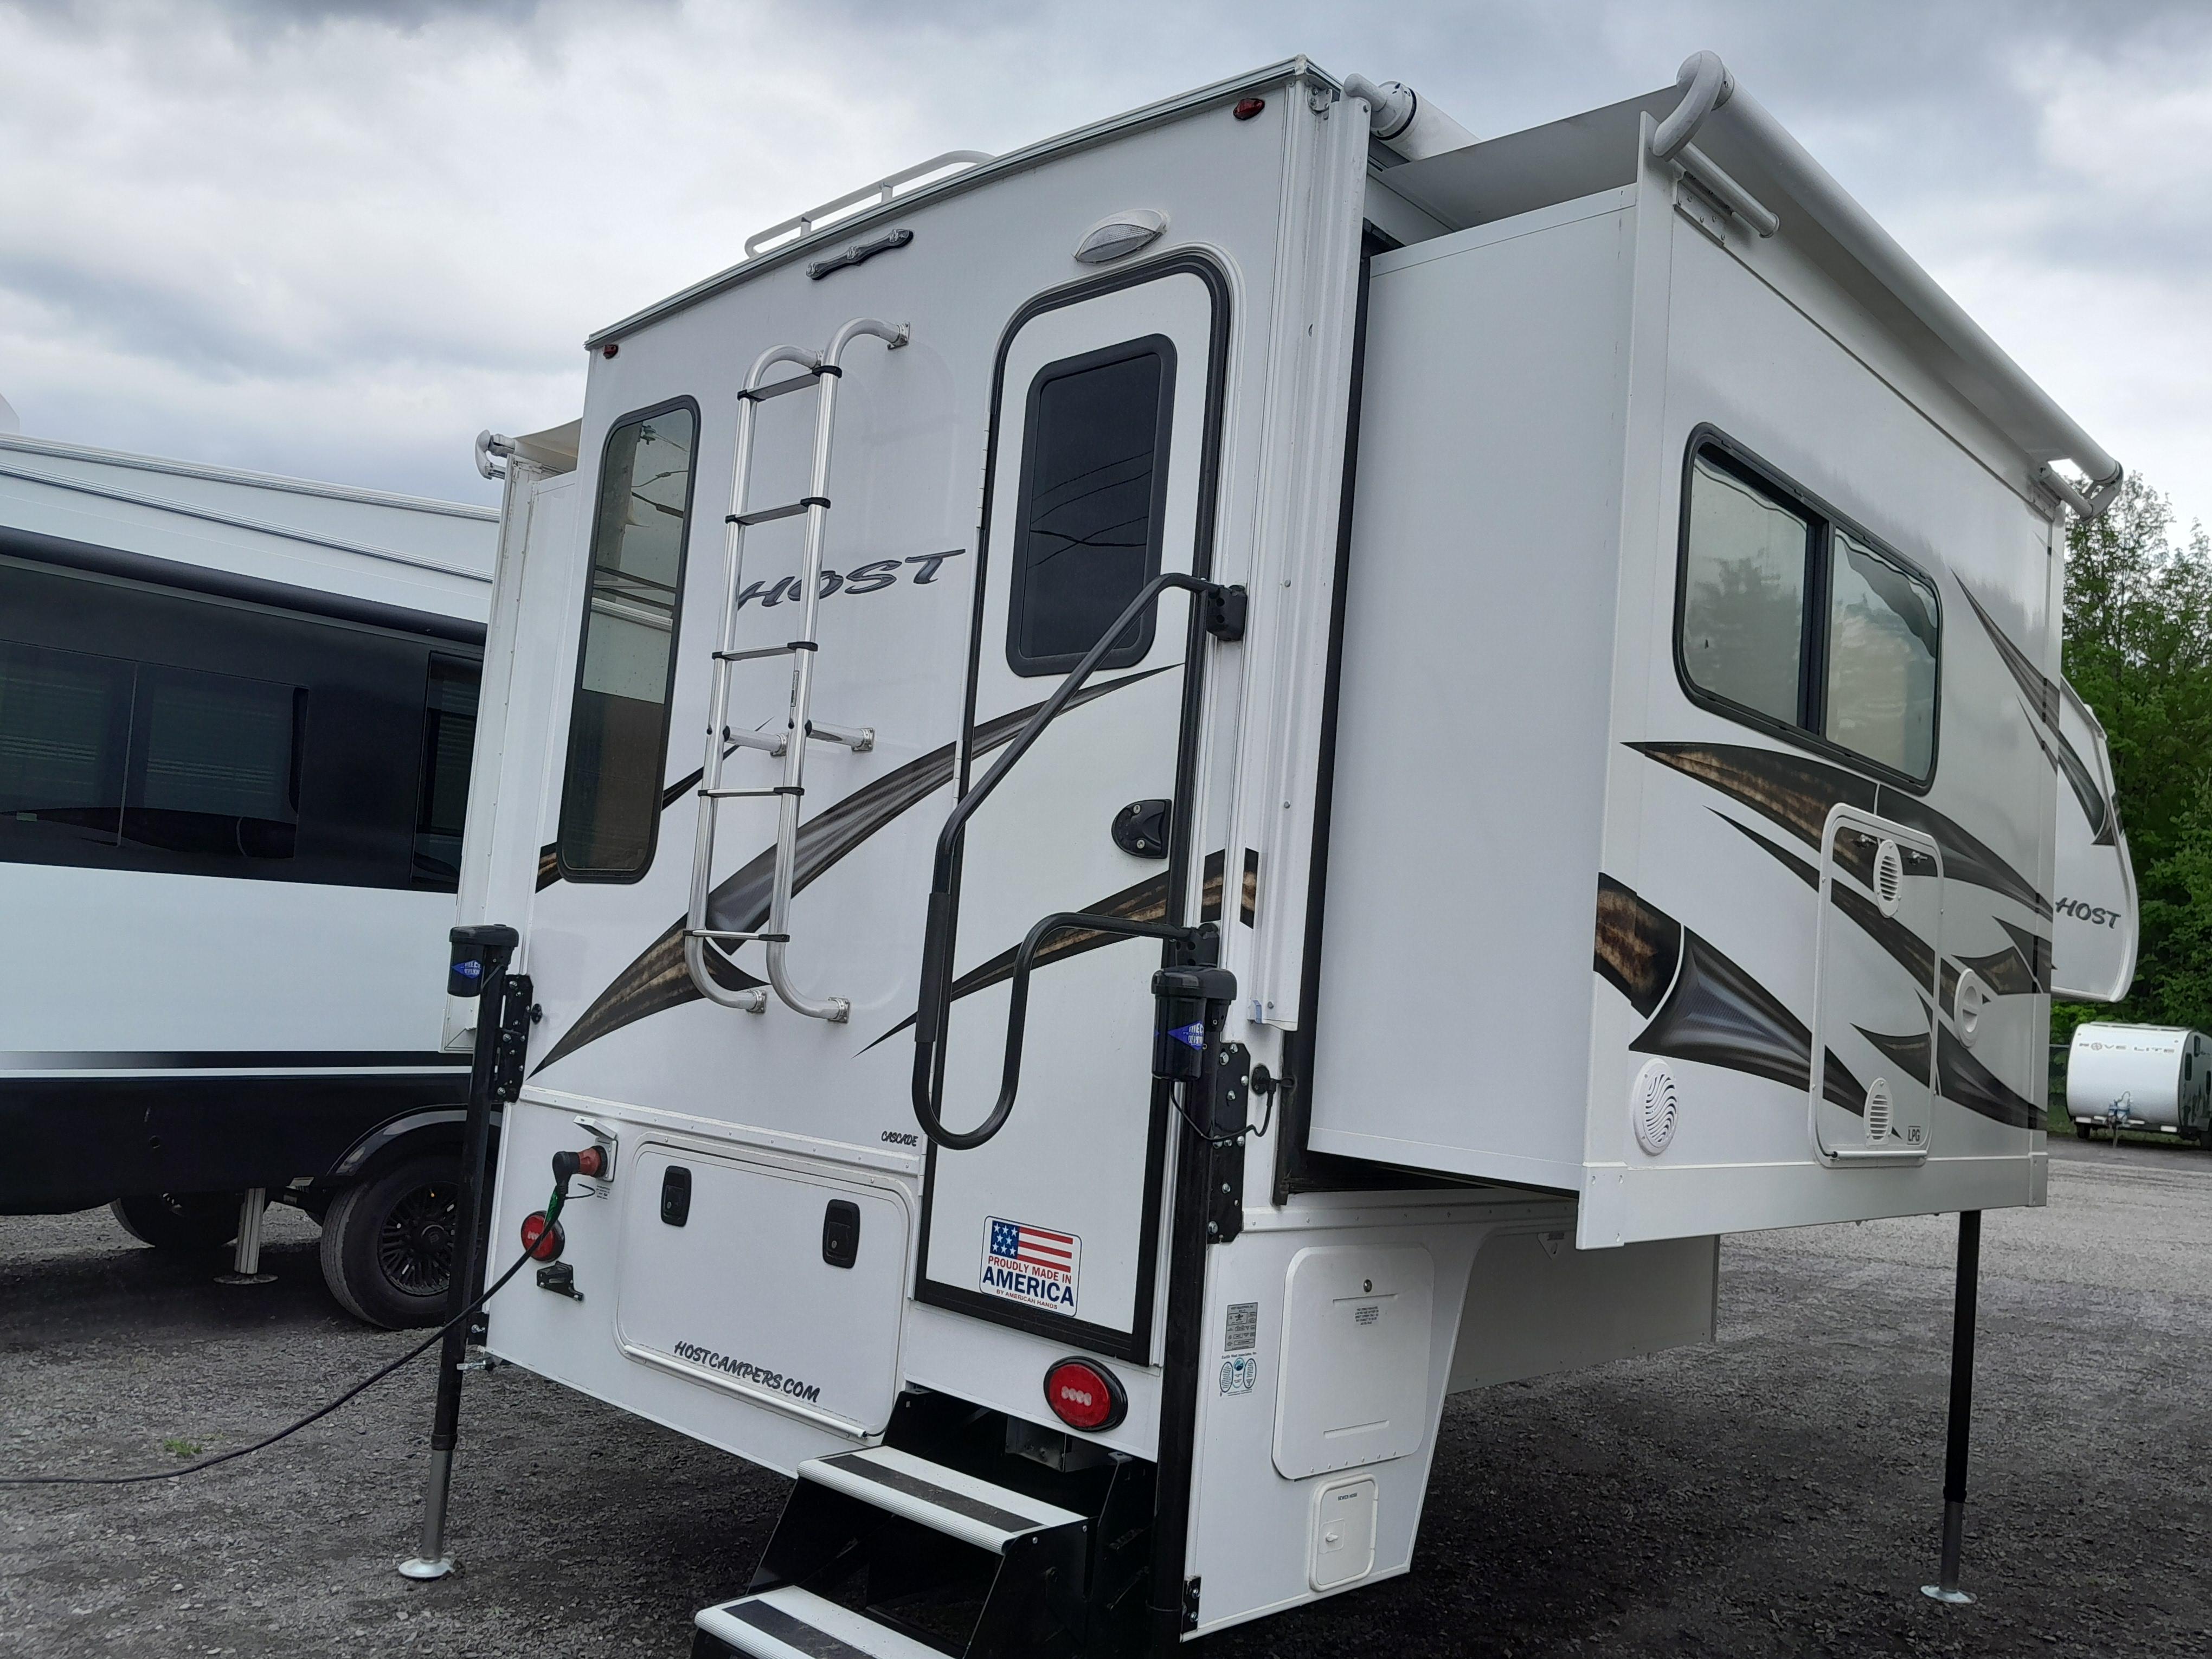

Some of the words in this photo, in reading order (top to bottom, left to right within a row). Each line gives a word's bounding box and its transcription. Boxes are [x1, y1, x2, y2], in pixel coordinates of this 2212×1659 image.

[738, 549, 966, 611] HOST
[2055, 897, 2121, 929] HOST
[881, 1130, 918, 1147] CASCADE
[1908, 1129, 1920, 1142] LPG
[988, 1256, 1030, 1274] PROUDLY
[1032, 1266, 1059, 1282] MADE
[1062, 1274, 1072, 1285] IN
[982, 1266, 1075, 1307] AMERICA
[1005, 1291, 1036, 1304] AMERICAN
[1037, 1300, 1058, 1310] HANDS
[674, 1340, 821, 1403] HOSTCAMPERS.COM
